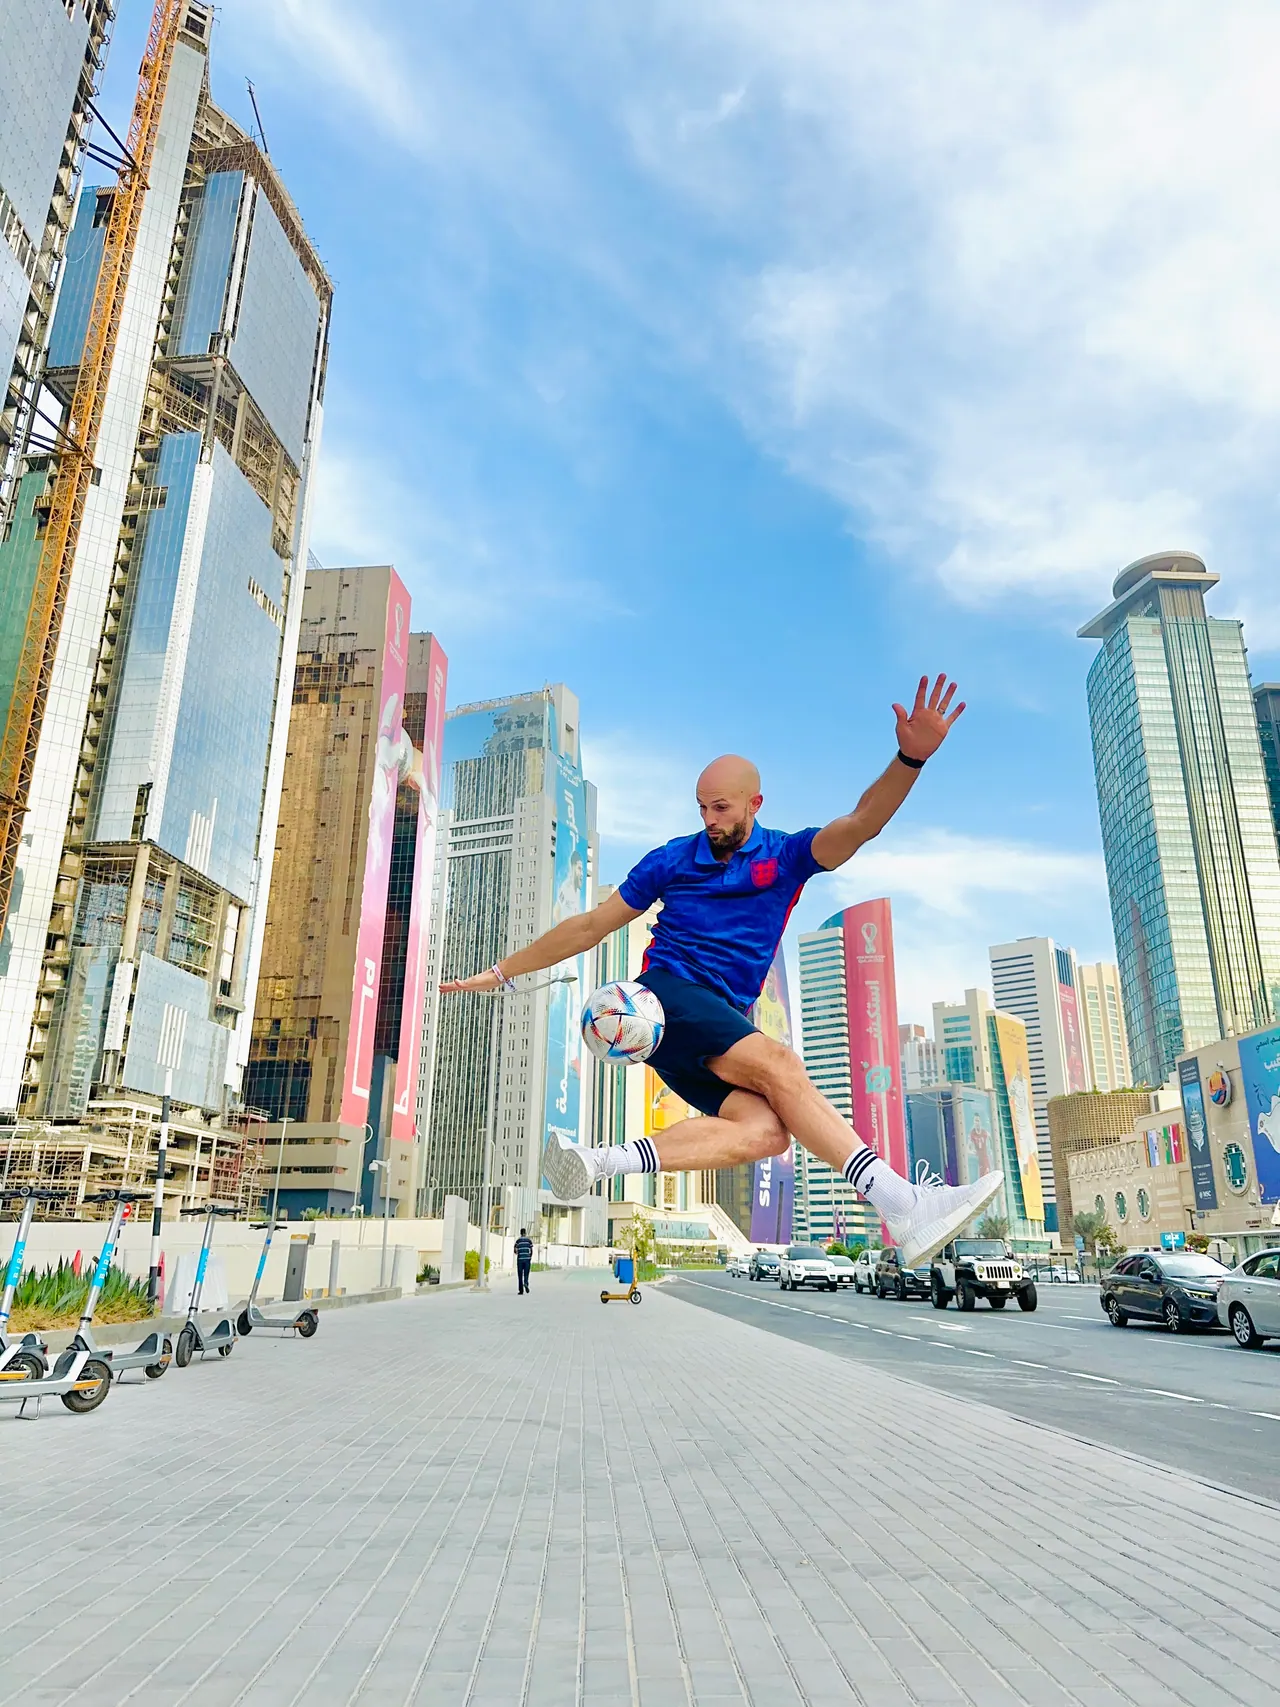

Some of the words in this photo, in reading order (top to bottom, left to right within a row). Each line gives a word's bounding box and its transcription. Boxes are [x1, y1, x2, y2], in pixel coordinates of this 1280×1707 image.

[759, 1156, 772, 1207] Ski
[13, 1249, 25, 1278] BIRD
[98, 1250, 112, 1279] BIRD
